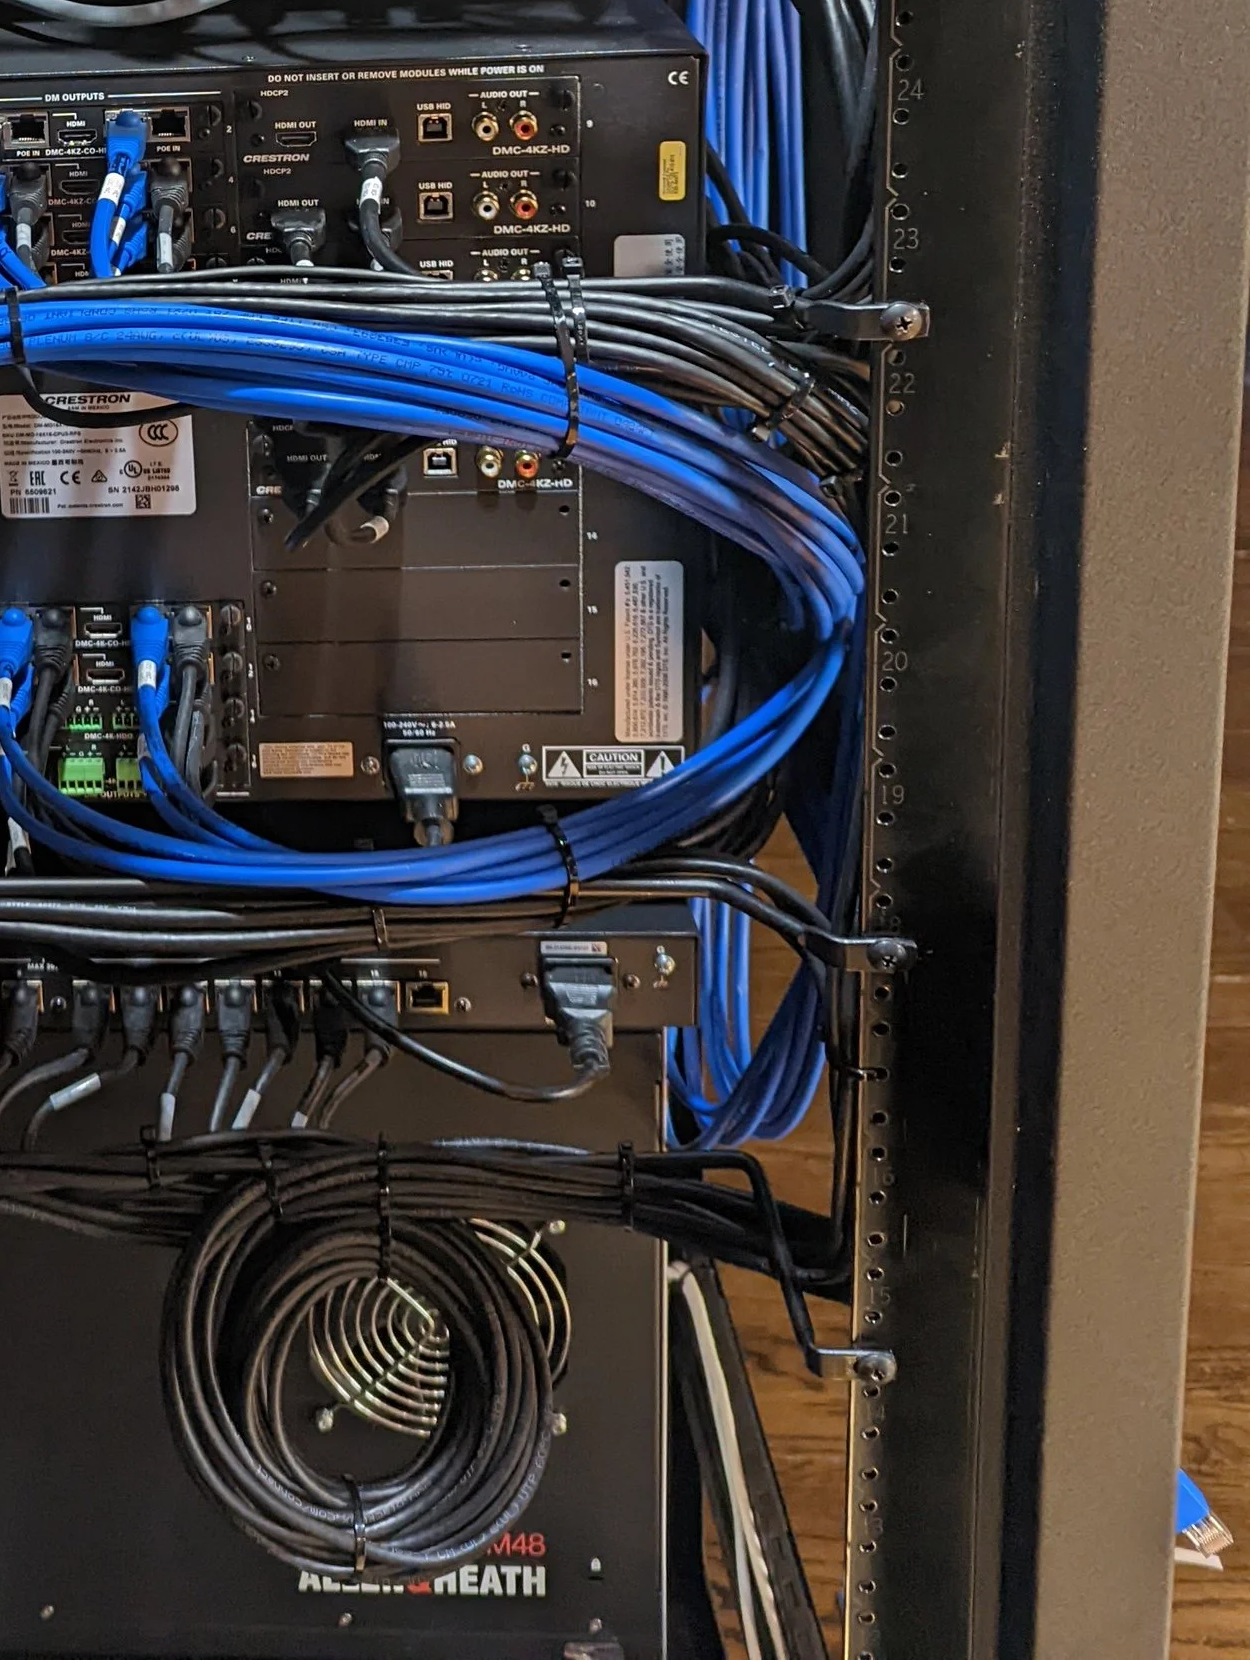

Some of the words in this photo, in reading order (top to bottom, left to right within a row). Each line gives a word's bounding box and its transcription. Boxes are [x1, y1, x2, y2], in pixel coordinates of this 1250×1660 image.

[284, 74, 303, 82] NOT
[306, 73, 339, 81] INSERT
[342, 72, 355, 80] OR
[358, 71, 397, 79] REMOVE
[400, 69, 446, 77] MODULES
[448, 67, 478, 75] WHILE
[480, 66, 515, 75] POWER
[529, 65, 544, 73] ON
[510, 90, 527, 98] OUT
[897, 81, 924, 102] 24
[45, 93, 60, 102] DM
[62, 92, 105, 102] OUTPUTS
[31, 149, 40, 157] IN
[492, 145, 570, 155] DMC-4KZ-HD
[243, 154, 310, 163] CRESTRON
[511, 170, 528, 178] OUT
[419, 182, 435, 190] USB
[278, 199, 300, 207] HDMI
[301, 199, 319, 207] OUT
[494, 225, 570, 234] DMC-4KZ-HD
[894, 229, 919, 251] 23
[420, 260, 436, 268] USB
[438, 259, 453, 267] HID
[889, 374, 916, 395] 22
[498, 479, 573, 489] DMC-4KZ-HD
[885, 515, 911, 535] 21
[881, 651, 908, 672] 20
[588, 753, 638, 762] CAUTION
